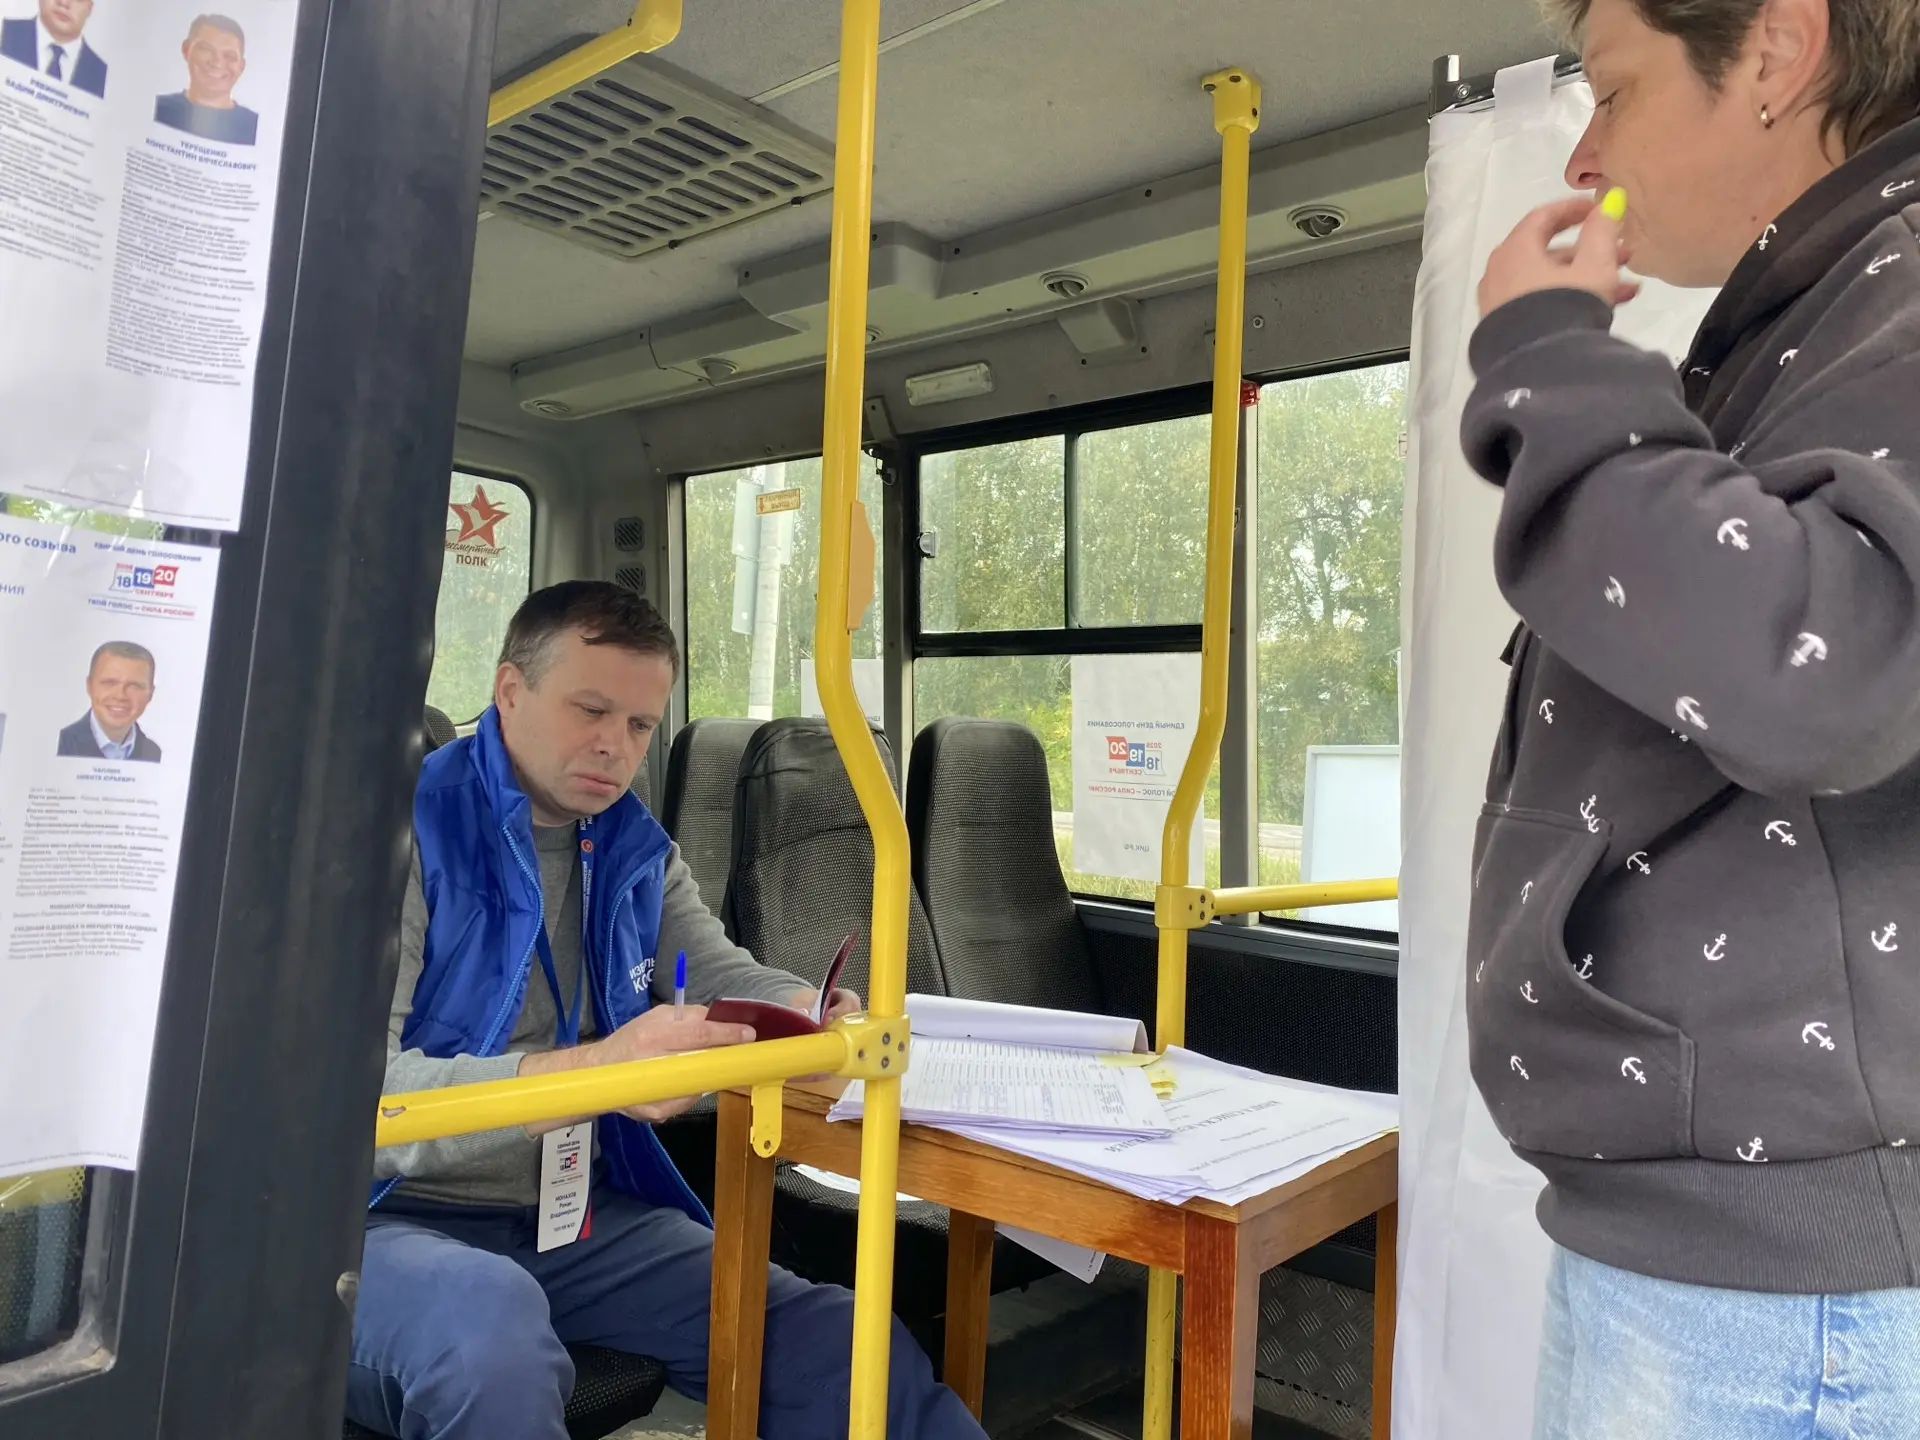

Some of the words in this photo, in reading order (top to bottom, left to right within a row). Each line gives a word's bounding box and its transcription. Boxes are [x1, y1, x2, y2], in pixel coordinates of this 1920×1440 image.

[456, 554, 488, 567] ПОЛК
[116, 575, 132, 589] 18
[135, 571, 152, 586] 19
[154, 568, 175, 583] 20
